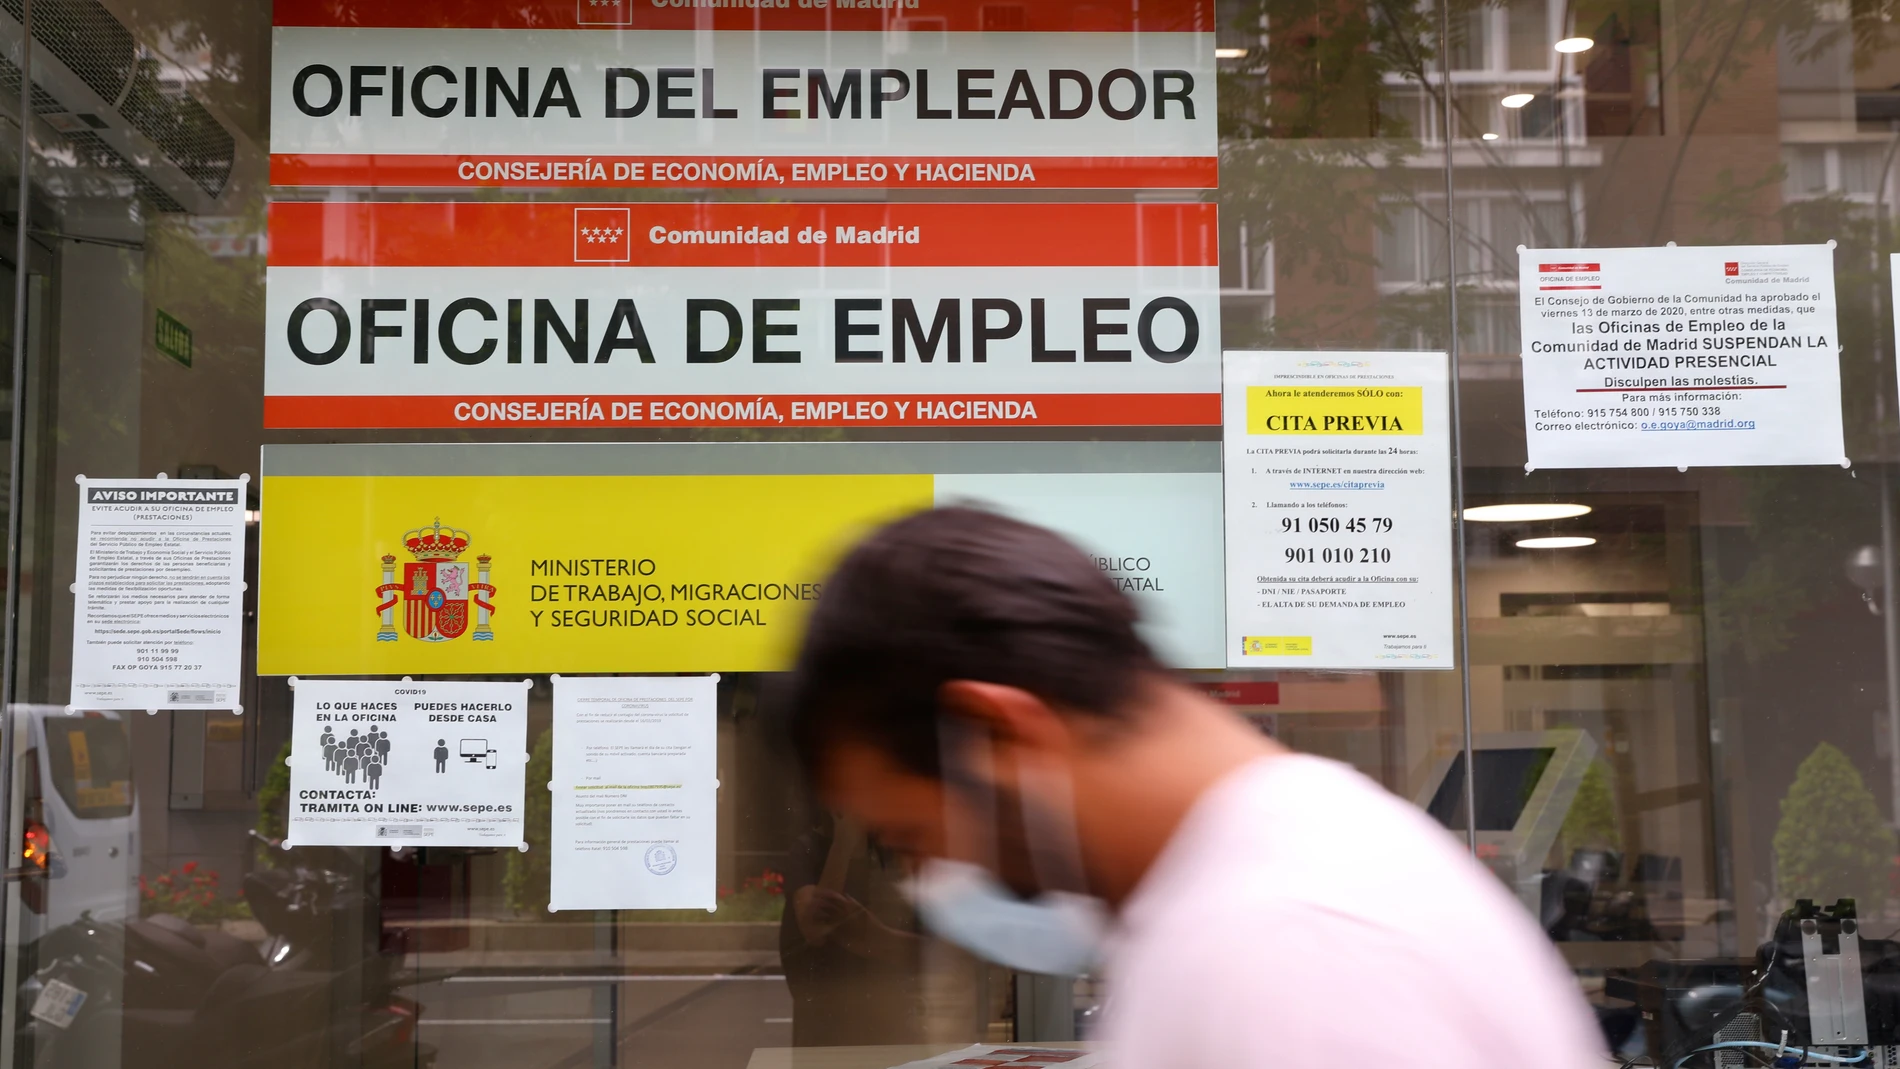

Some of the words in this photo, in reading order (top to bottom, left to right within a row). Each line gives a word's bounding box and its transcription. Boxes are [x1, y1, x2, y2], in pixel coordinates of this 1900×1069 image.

[292, 64, 582, 118] OFICINA
[604, 67, 738, 119] DEL
[762, 68, 1196, 121] EMPLEADOR
[457, 159, 607, 181] CONSEJERÍA
[613, 164, 644, 180] DE
[651, 159, 784, 183] ECONOMÍA,
[791, 164, 887, 182] EMPLEO
[894, 164, 911, 182] Y
[916, 164, 1035, 182] HACIENDA
[649, 225, 789, 244] Comunidad
[797, 226, 827, 244] de
[835, 226, 920, 244] Madrid
[1534, 297, 1545, 305] El
[1547, 297, 1589, 307] Consejo
[1592, 296, 1604, 305] de
[1608, 295, 1654, 304] Gobierno
[1657, 295, 1670, 303] de
[1673, 294, 1681, 303] la
[1684, 294, 1742, 303] Comunidad
[1745, 293, 1757, 302] ha
[1760, 293, 1809, 303] aprobado
[1812, 292, 1820, 301] el
[1541, 309, 1578, 318] viernes
[1583, 309, 1593, 317] 13
[1596, 308, 1608, 316] de
[1646, 307, 1658, 315] de
[1661, 306, 1687, 316] 2020,
[1690, 307, 1716, 315] entre
[1718, 306, 1744, 314] otras
[1747, 305, 1794, 315] medidas,
[1797, 306, 1815, 316] que
[287, 297, 656, 365] OFICINA
[686, 298, 801, 364] DE
[834, 296, 1200, 364] EMPLEO
[1572, 323, 1594, 334] las
[1598, 322, 1661, 333] Oficinas
[1665, 321, 1684, 333] de
[1689, 320, 1745, 334] Empleo
[1750, 319, 1769, 331] de
[1773, 319, 1785, 331] la
[1531, 340, 1618, 353] Comunidad
[1623, 339, 1642, 351] de
[1646, 338, 1698, 351] Madrid
[1703, 336, 1802, 349] SUSPENDAN
[1807, 336, 1828, 348] LA
[1584, 356, 1670, 370] ACTIVIDAD
[1675, 354, 1776, 368] PRESENCIAL
[1605, 376, 1667, 390] Disculpen
[1671, 376, 1690, 387] las
[1694, 374, 1758, 386] molestias.
[1357, 388, 1384, 397] SÓLO
[1622, 393, 1646, 402] Para
[1649, 393, 1671, 401] más
[1674, 391, 1742, 401] información:
[454, 398, 605, 421] CONSEJERÍA
[611, 403, 643, 420] DE
[649, 398, 784, 424] ECONOMÍA,
[791, 401, 888, 420] EMPLEO
[894, 401, 911, 420] Y
[916, 401, 1037, 420] HACIENDA
[1534, 408, 1584, 418] Teléfono:
[1587, 408, 1606, 418] 915
[1609, 408, 1628, 417] 754
[1631, 407, 1649, 417] 800
[1652, 407, 1656, 417] /
[1658, 407, 1678, 416] 915
[1680, 406, 1699, 416] 750
[1702, 406, 1721, 416] 338
[1266, 415, 1317, 431] CITA
[1323, 416, 1403, 431] PREVIA
[1535, 422, 1572, 431] Correo
[1575, 421, 1638, 430] electrónico:
[1641, 419, 1755, 431] o.e.goya@madrid.org
[1290, 481, 1384, 490] www.sepe.es/citaprevia
[92, 491, 138, 500] AVISO
[141, 491, 234, 501] IMPORTANTE
[1282, 517, 1301, 533] 91
[1309, 517, 1339, 533] 050
[1345, 517, 1366, 533] 45
[1372, 517, 1393, 533] 79
[1285, 548, 1315, 564] 901
[1322, 548, 1354, 563] 010
[1360, 548, 1391, 563] 210
[531, 559, 656, 576] MINISTERIO
[531, 585, 559, 602] DE
[563, 584, 665, 606] TRABAJO,
[671, 583, 822, 601] MIGRACIONES
[530, 610, 543, 627] Y
[551, 609, 678, 627] SEGURIDAD
[686, 609, 766, 626] SOCIAL
[316, 702, 330, 710] LO
[334, 702, 357, 711] QUE
[414, 703, 457, 711] PUEDES
[461, 703, 512, 711] HACERLO
[352, 714, 396, 722] OFICINA
[299, 790, 376, 799] CONTACTA:
[300, 804, 359, 813] TRAMITA
[364, 804, 385, 813] ON
[388, 804, 422, 813] LINE:
[426, 804, 512, 814] www.sepe.es
